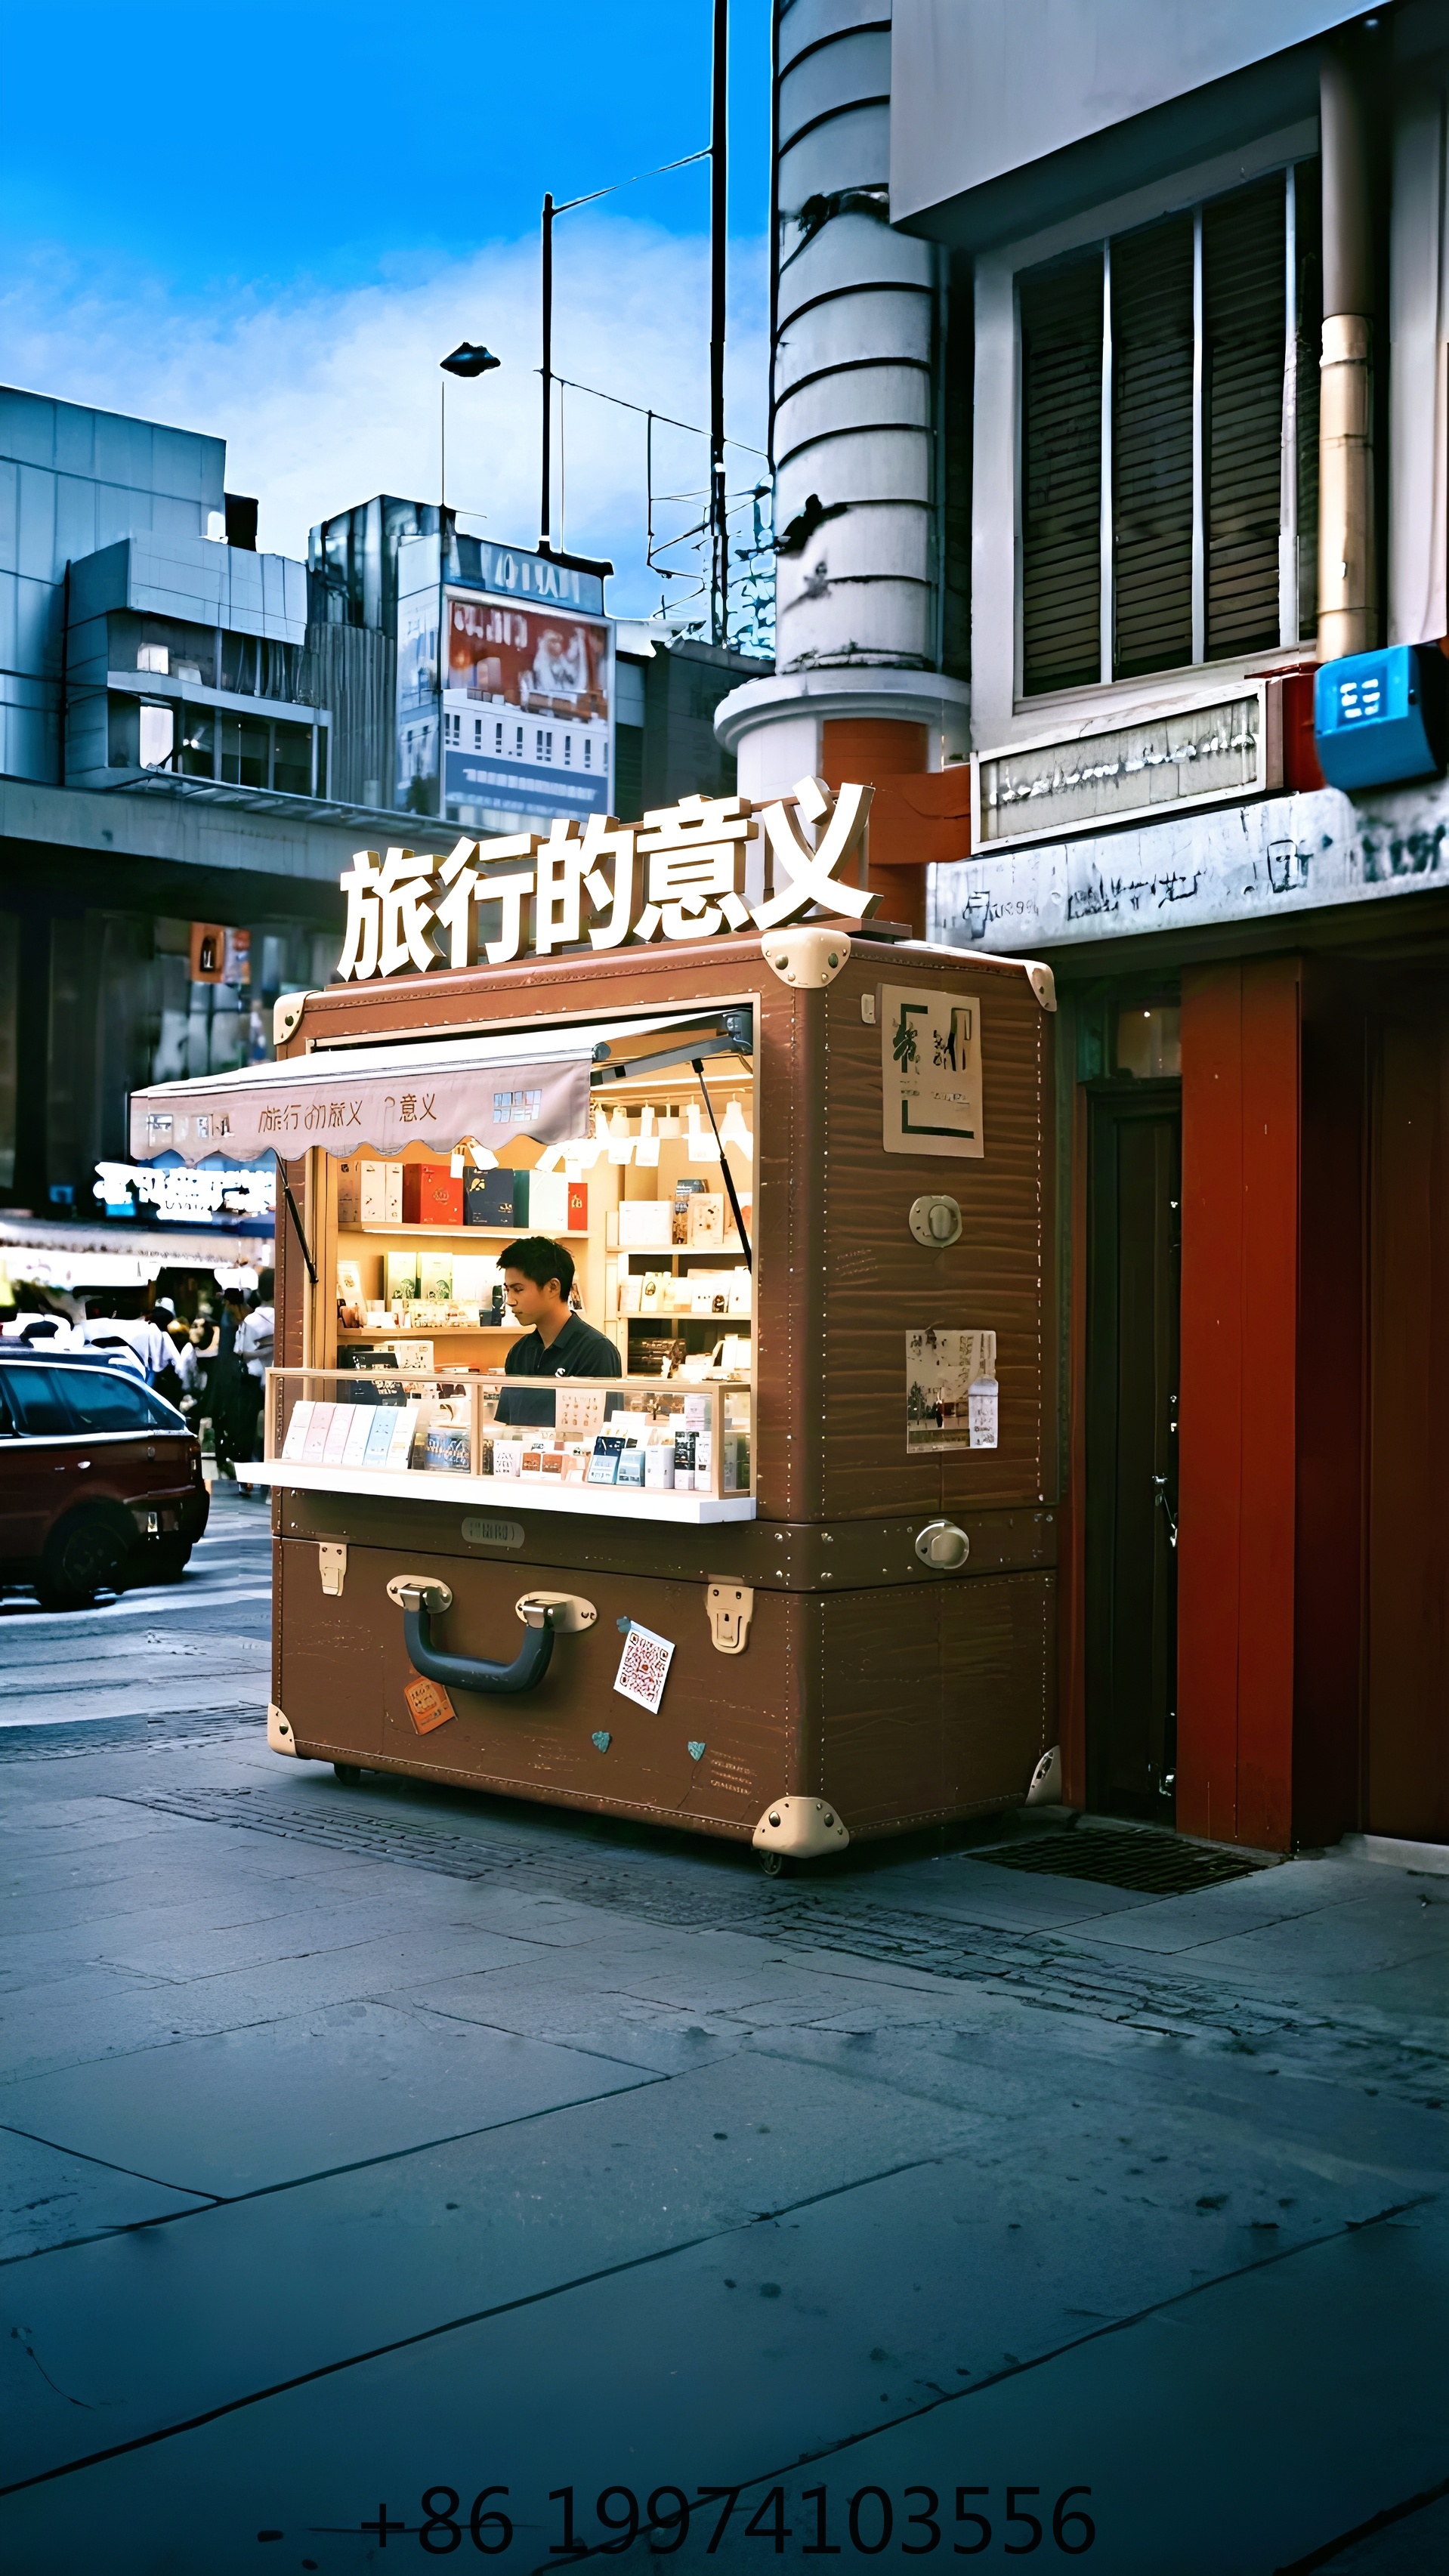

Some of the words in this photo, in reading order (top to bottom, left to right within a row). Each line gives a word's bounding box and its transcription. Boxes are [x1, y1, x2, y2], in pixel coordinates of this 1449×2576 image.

[337, 775, 884, 982] 旅行的意义
[399, 1092, 437, 1123] 意义
